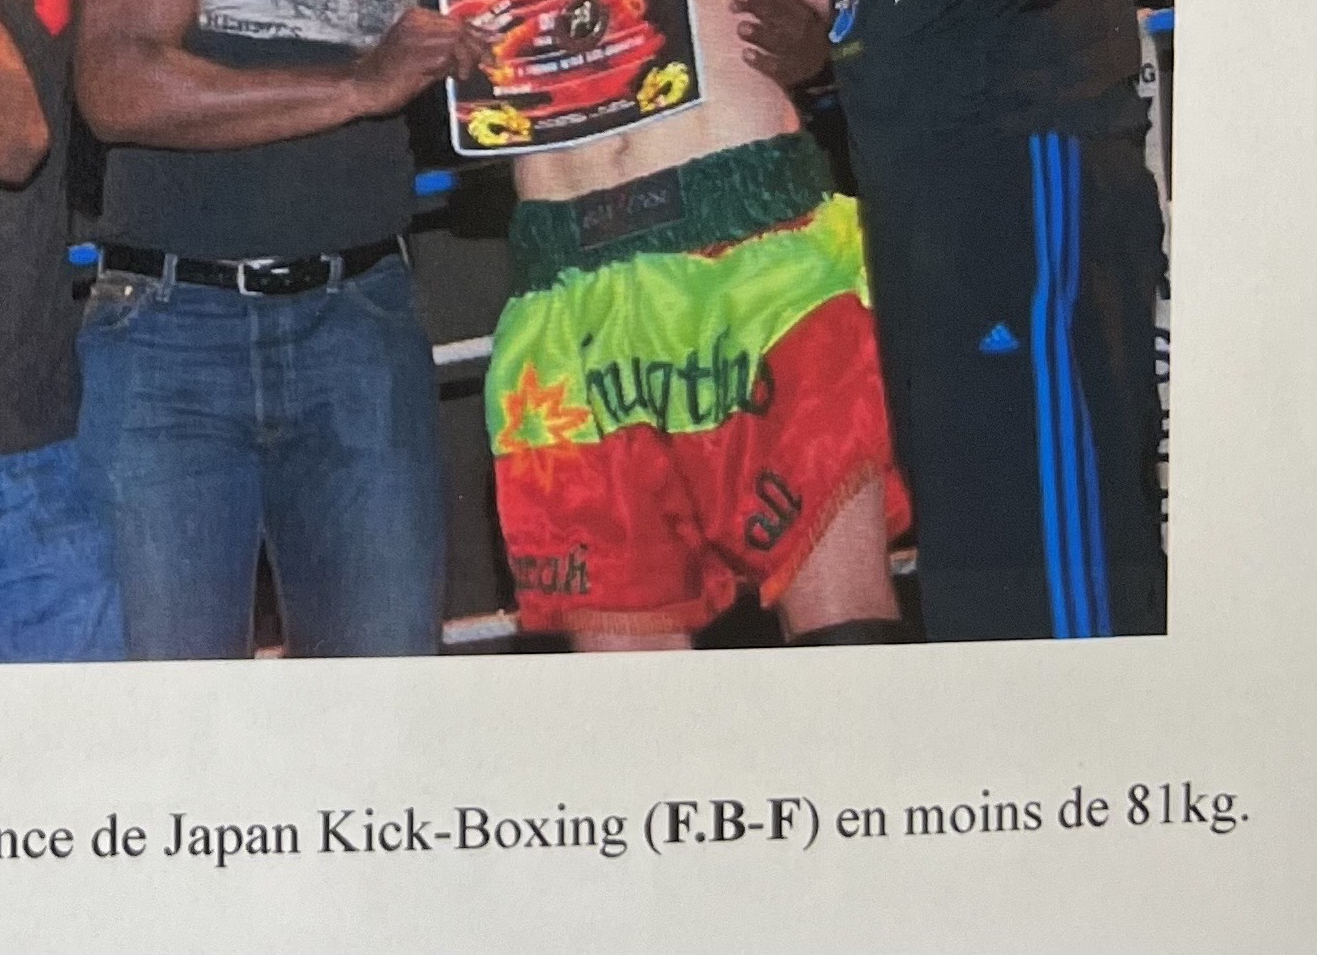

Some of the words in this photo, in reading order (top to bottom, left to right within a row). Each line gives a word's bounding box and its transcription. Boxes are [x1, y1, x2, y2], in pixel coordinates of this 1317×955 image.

[91, 812, 147, 862] de
[163, 809, 301, 872] Japan
[319, 802, 628, 859] Kick-Boxing
[644, 797, 820, 855] (F.B-F)
[836, 807, 888, 839] en
[905, 789, 1043, 836] moins
[1058, 784, 1110, 830] de
[1127, 781, 1250, 835] 81kg.
